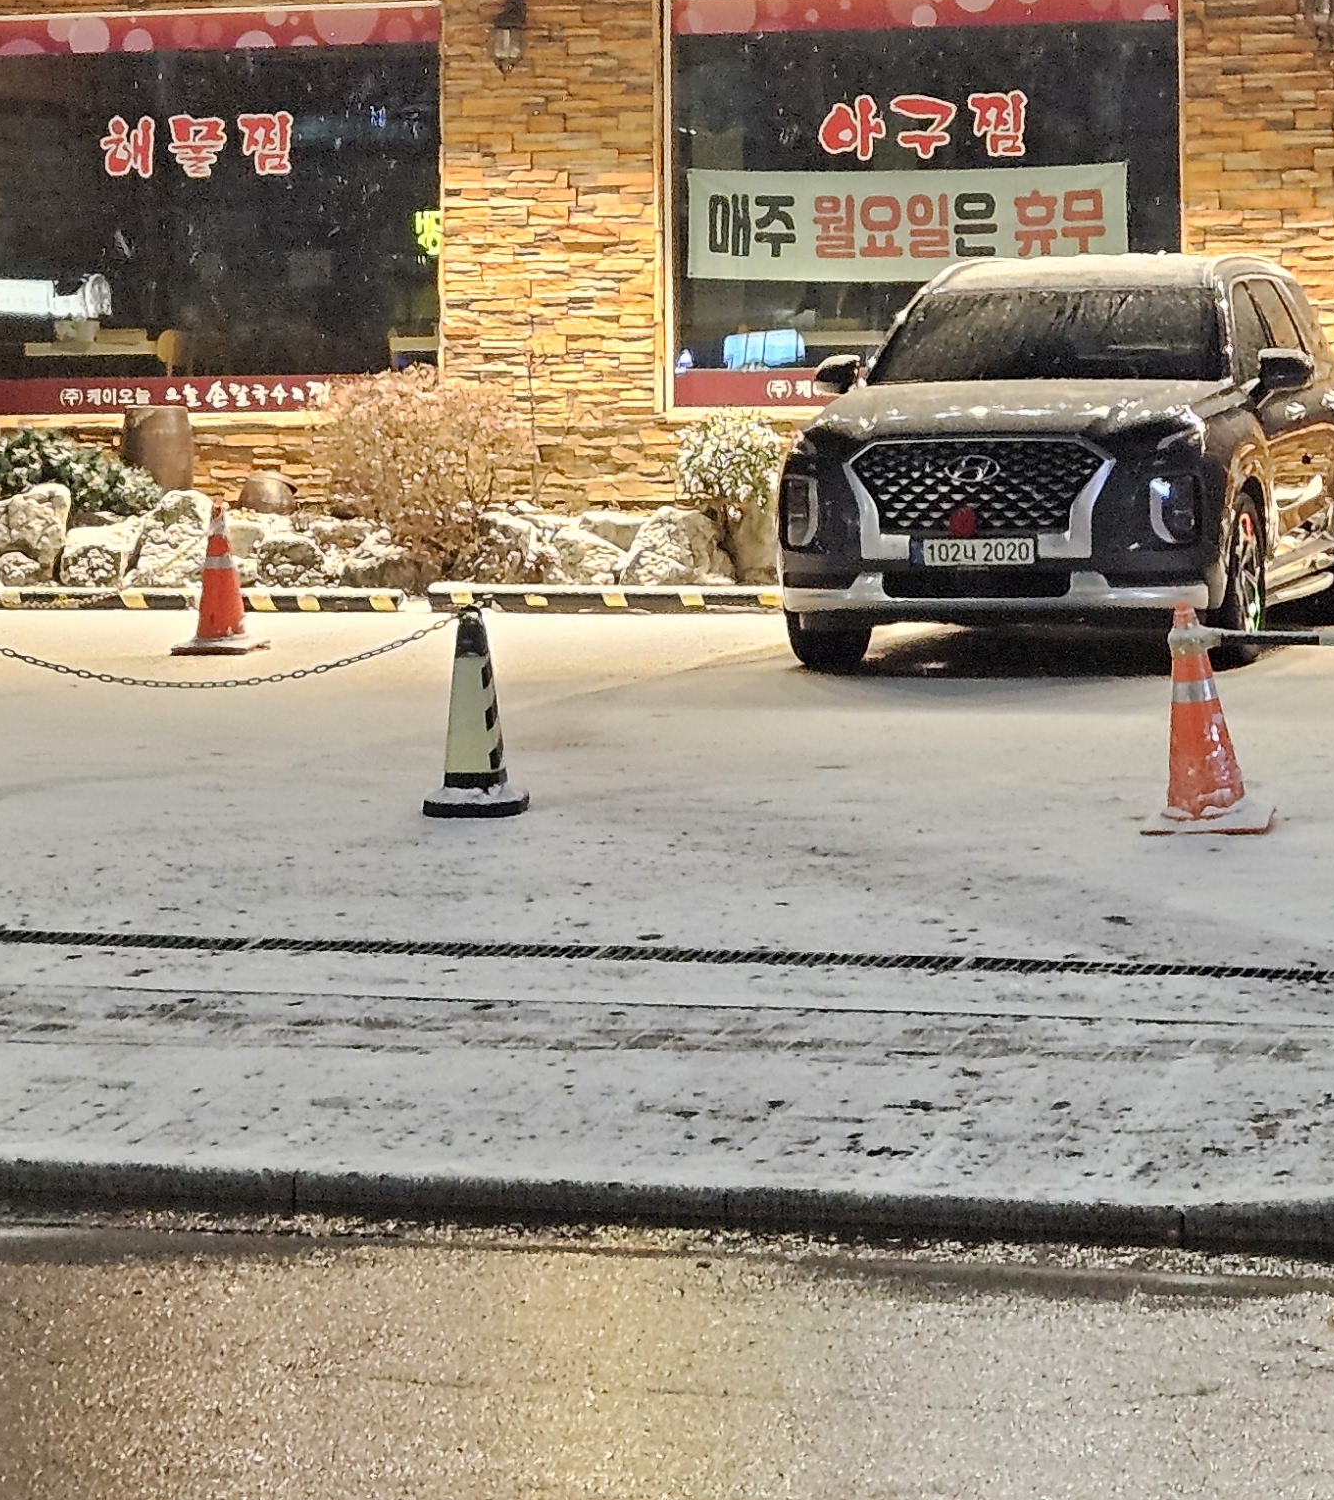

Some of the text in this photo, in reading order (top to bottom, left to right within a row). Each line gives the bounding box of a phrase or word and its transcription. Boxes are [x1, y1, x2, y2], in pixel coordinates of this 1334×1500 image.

[100, 110, 294, 178] 해물찜
[818, 89, 1028, 160] 아구찜
[707, 188, 1106, 259] 매주 월요일은 휴무
[982, 541, 1030, 562] 2020
